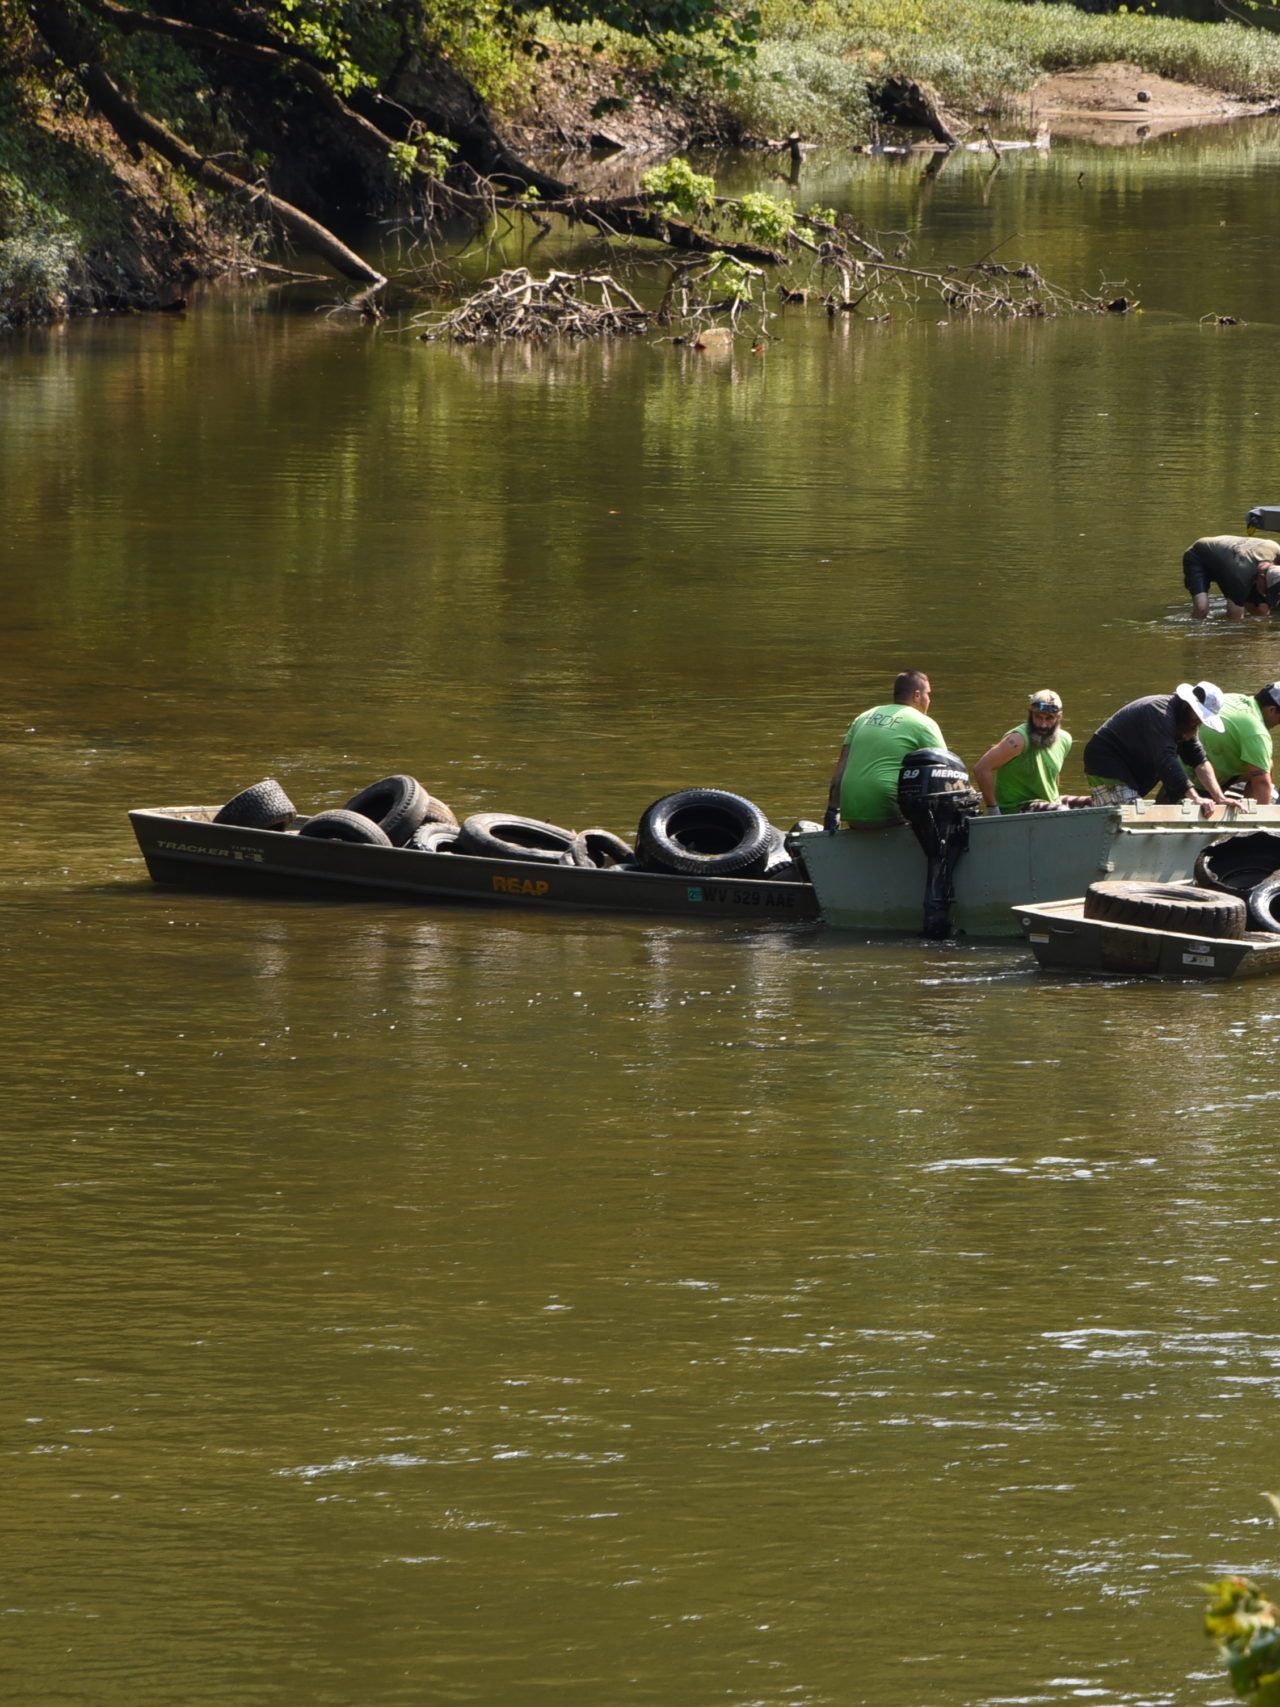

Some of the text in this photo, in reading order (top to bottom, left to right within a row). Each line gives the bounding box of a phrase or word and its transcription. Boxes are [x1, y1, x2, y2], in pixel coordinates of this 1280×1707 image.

[931, 769, 969, 781] MERCUR
[158, 840, 229, 857] TRACKER
[492, 875, 549, 896] REAP
[703, 887, 728, 903] WV
[733, 889, 760, 905] 529
